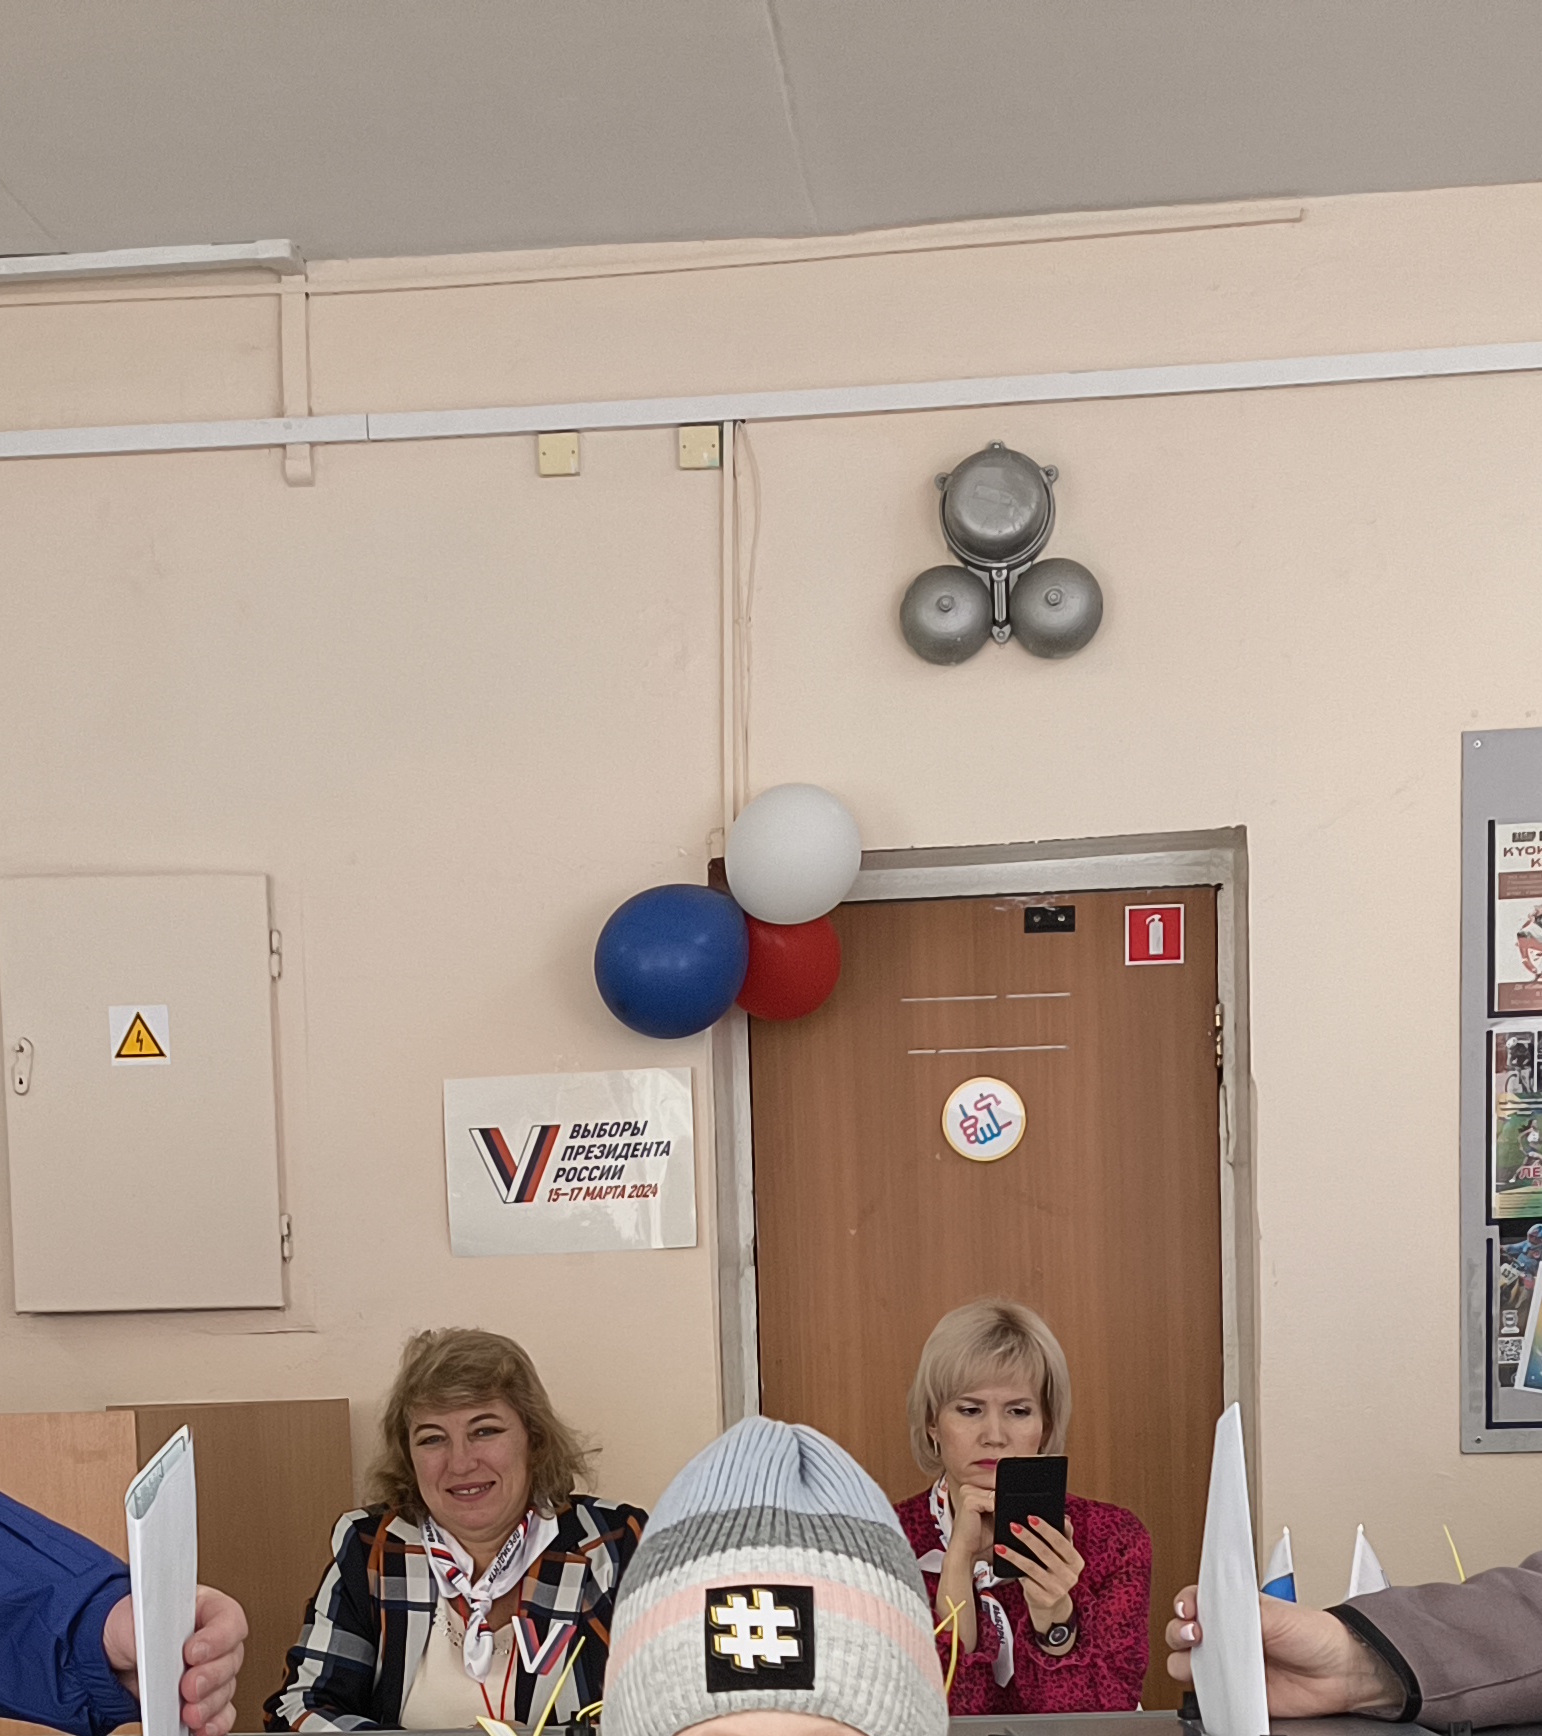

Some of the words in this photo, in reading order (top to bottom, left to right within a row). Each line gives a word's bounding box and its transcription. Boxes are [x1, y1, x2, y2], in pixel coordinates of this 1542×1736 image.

[569, 1120, 648, 1139] ВЫБОРЫ
[561, 1141, 671, 1161] ПРЕЗИДЕНТА
[552, 1164, 625, 1183] РОССИИ
[582, 1185, 626, 1201] МАРТА
[627, 1184, 658, 1199] 2024
